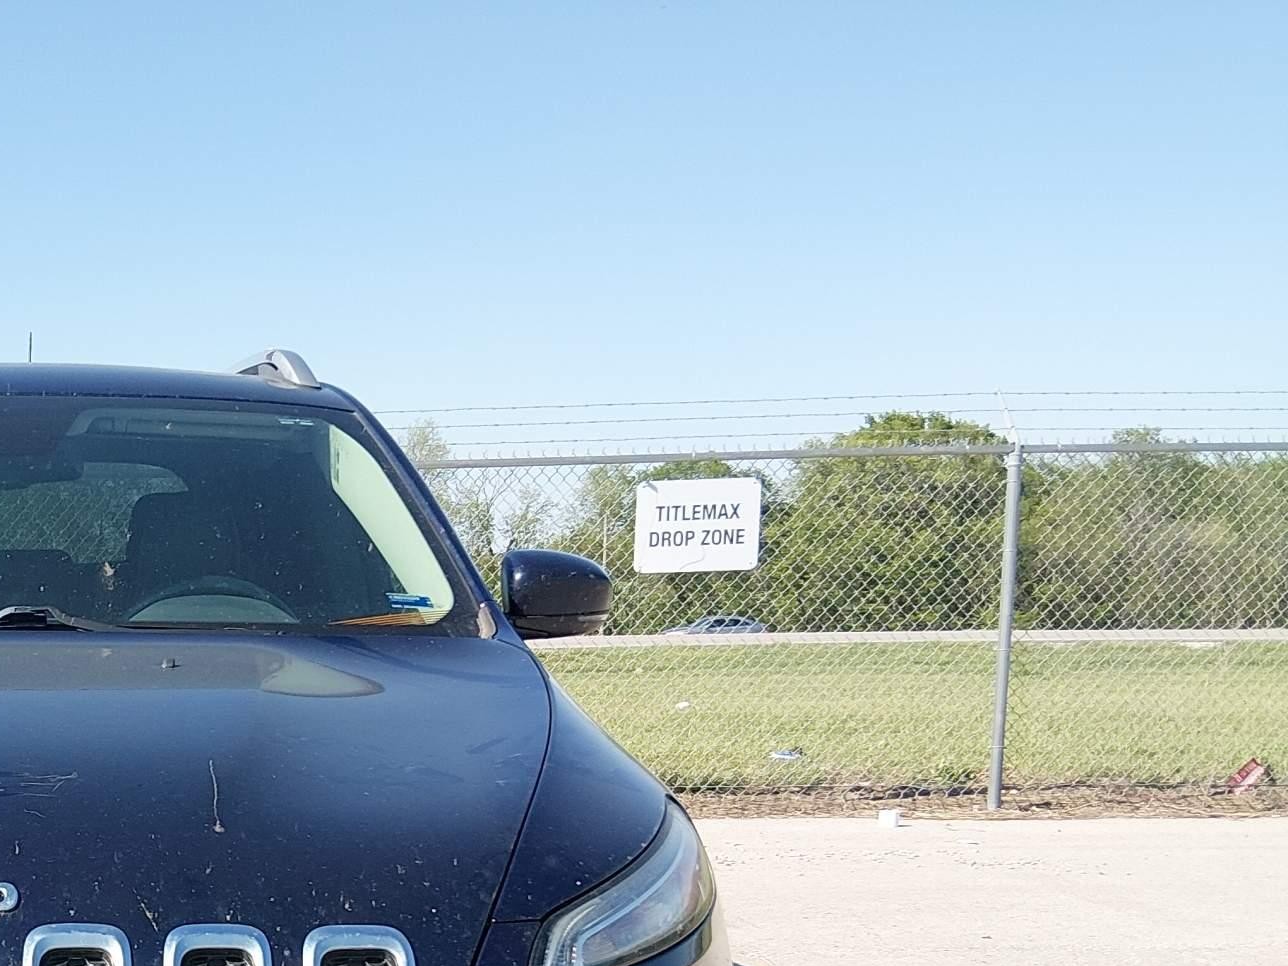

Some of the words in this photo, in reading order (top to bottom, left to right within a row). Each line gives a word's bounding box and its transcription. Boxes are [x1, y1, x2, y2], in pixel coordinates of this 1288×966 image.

[655, 503, 741, 522] TITLEMAX
[648, 530, 696, 548] DROP
[700, 528, 746, 546] ZONE
